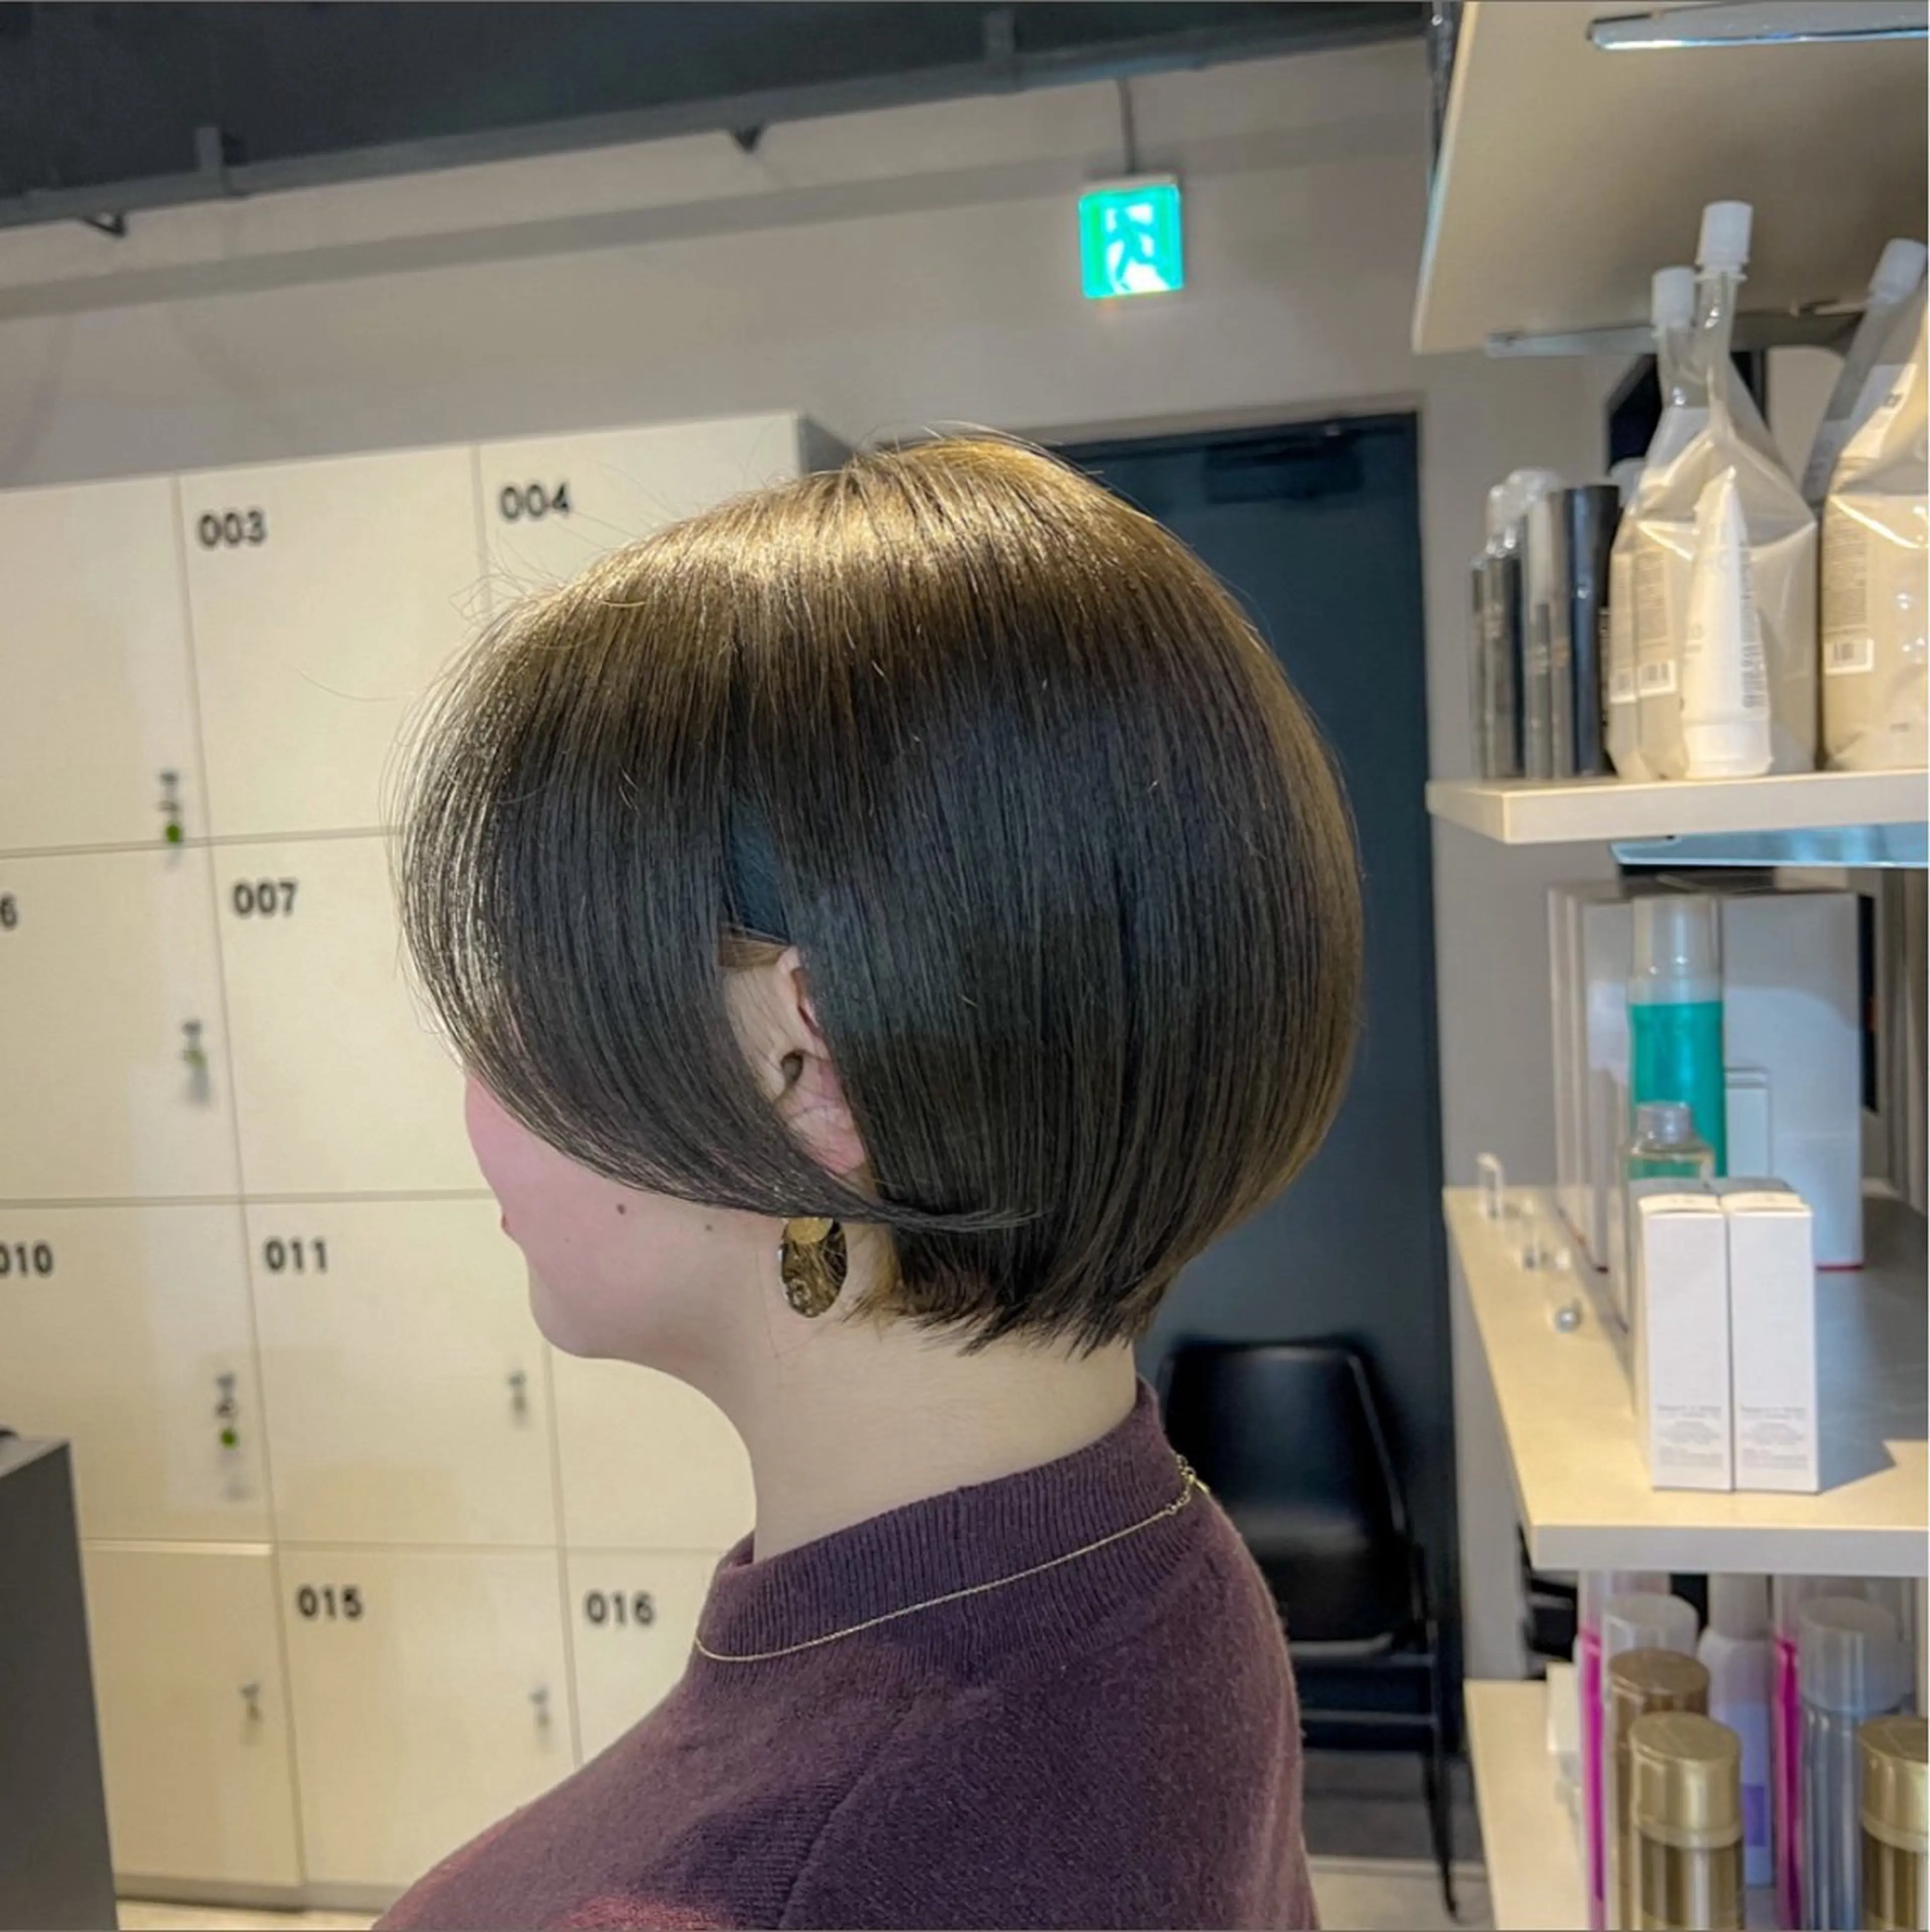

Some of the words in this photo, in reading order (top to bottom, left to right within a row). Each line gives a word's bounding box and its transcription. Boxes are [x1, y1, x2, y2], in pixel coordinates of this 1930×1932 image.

[500, 483, 570, 521] 004
[198, 509, 266, 548] 003
[232, 881, 298, 916] 007
[263, 1238, 327, 1273] 011
[296, 1585, 363, 1620] 015
[585, 1591, 654, 1626] 016
